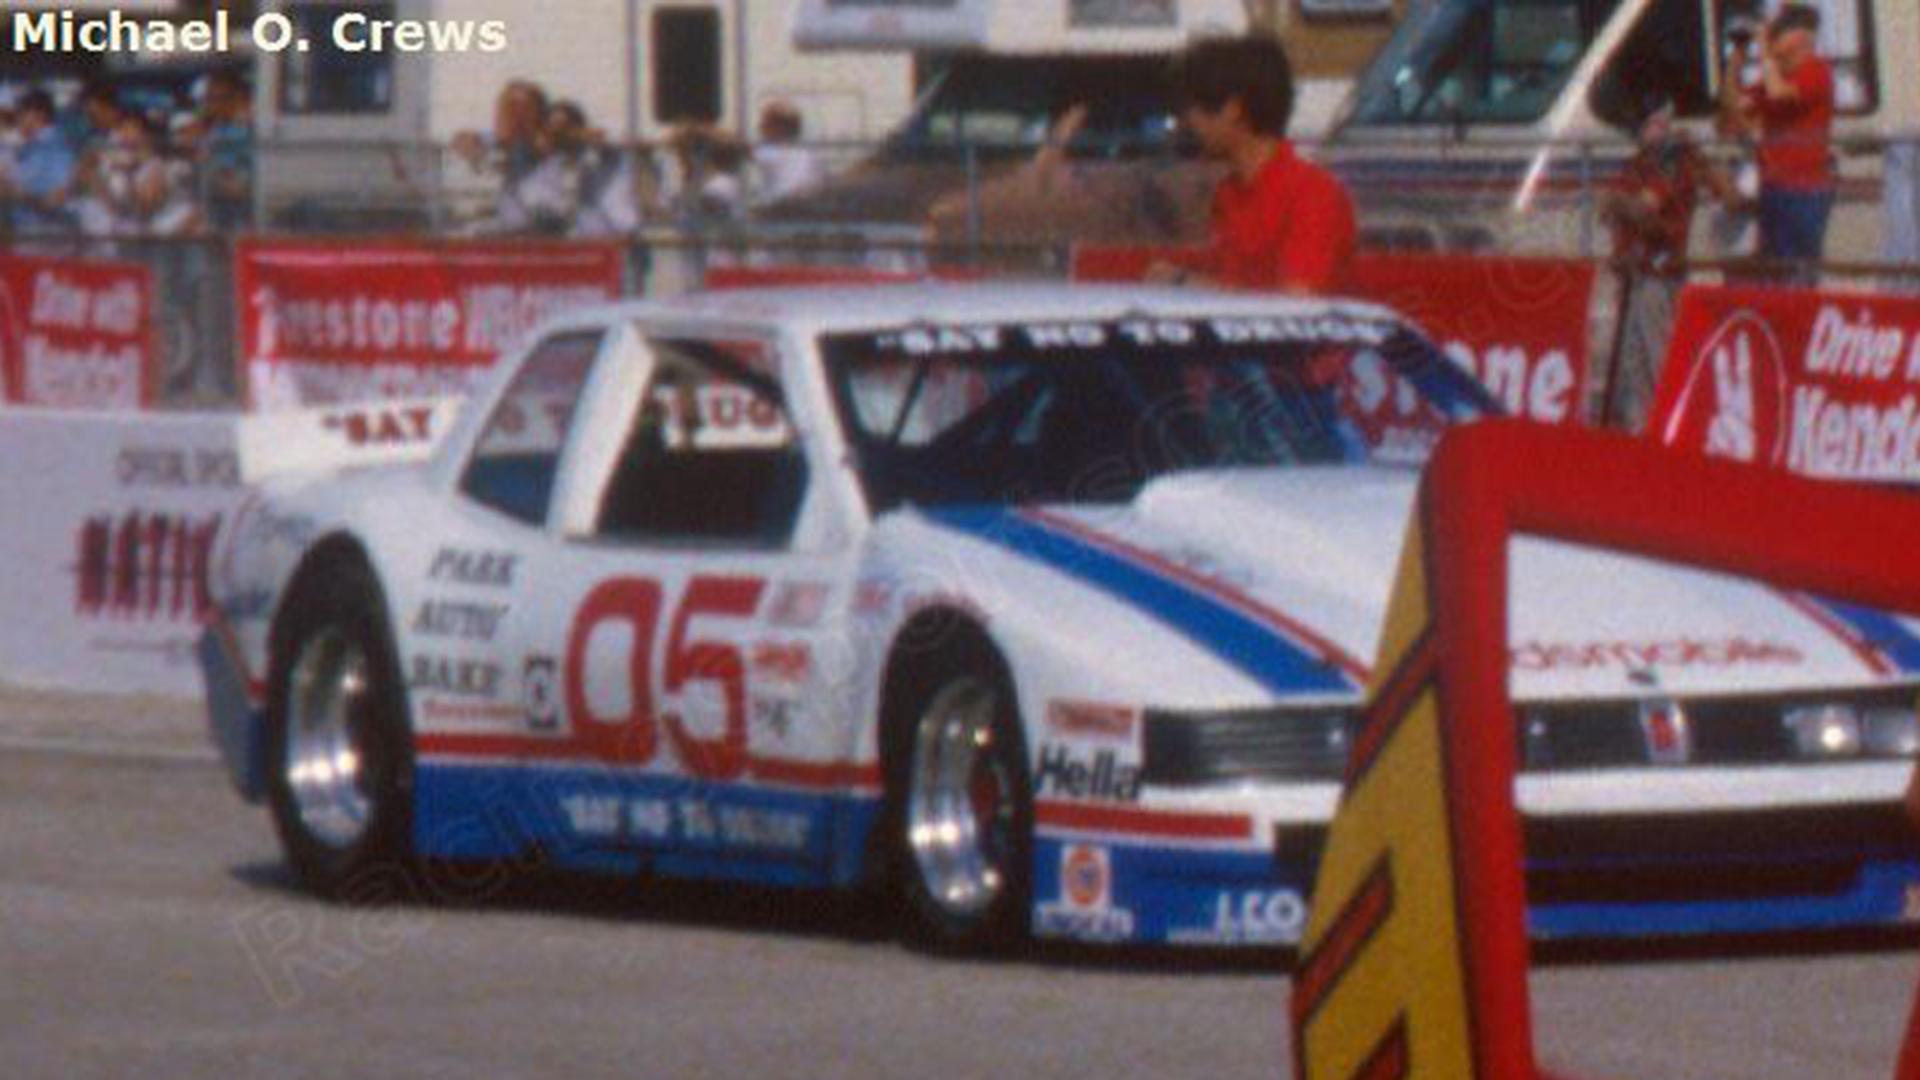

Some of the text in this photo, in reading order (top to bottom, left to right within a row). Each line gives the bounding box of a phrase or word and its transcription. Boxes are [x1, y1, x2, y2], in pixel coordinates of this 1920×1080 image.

[1806, 305, 1903, 380] Drive
[564, 573, 767, 779] 05
[1510, 636, 1804, 674] dsmobile
[1036, 743, 1141, 802] Hella
